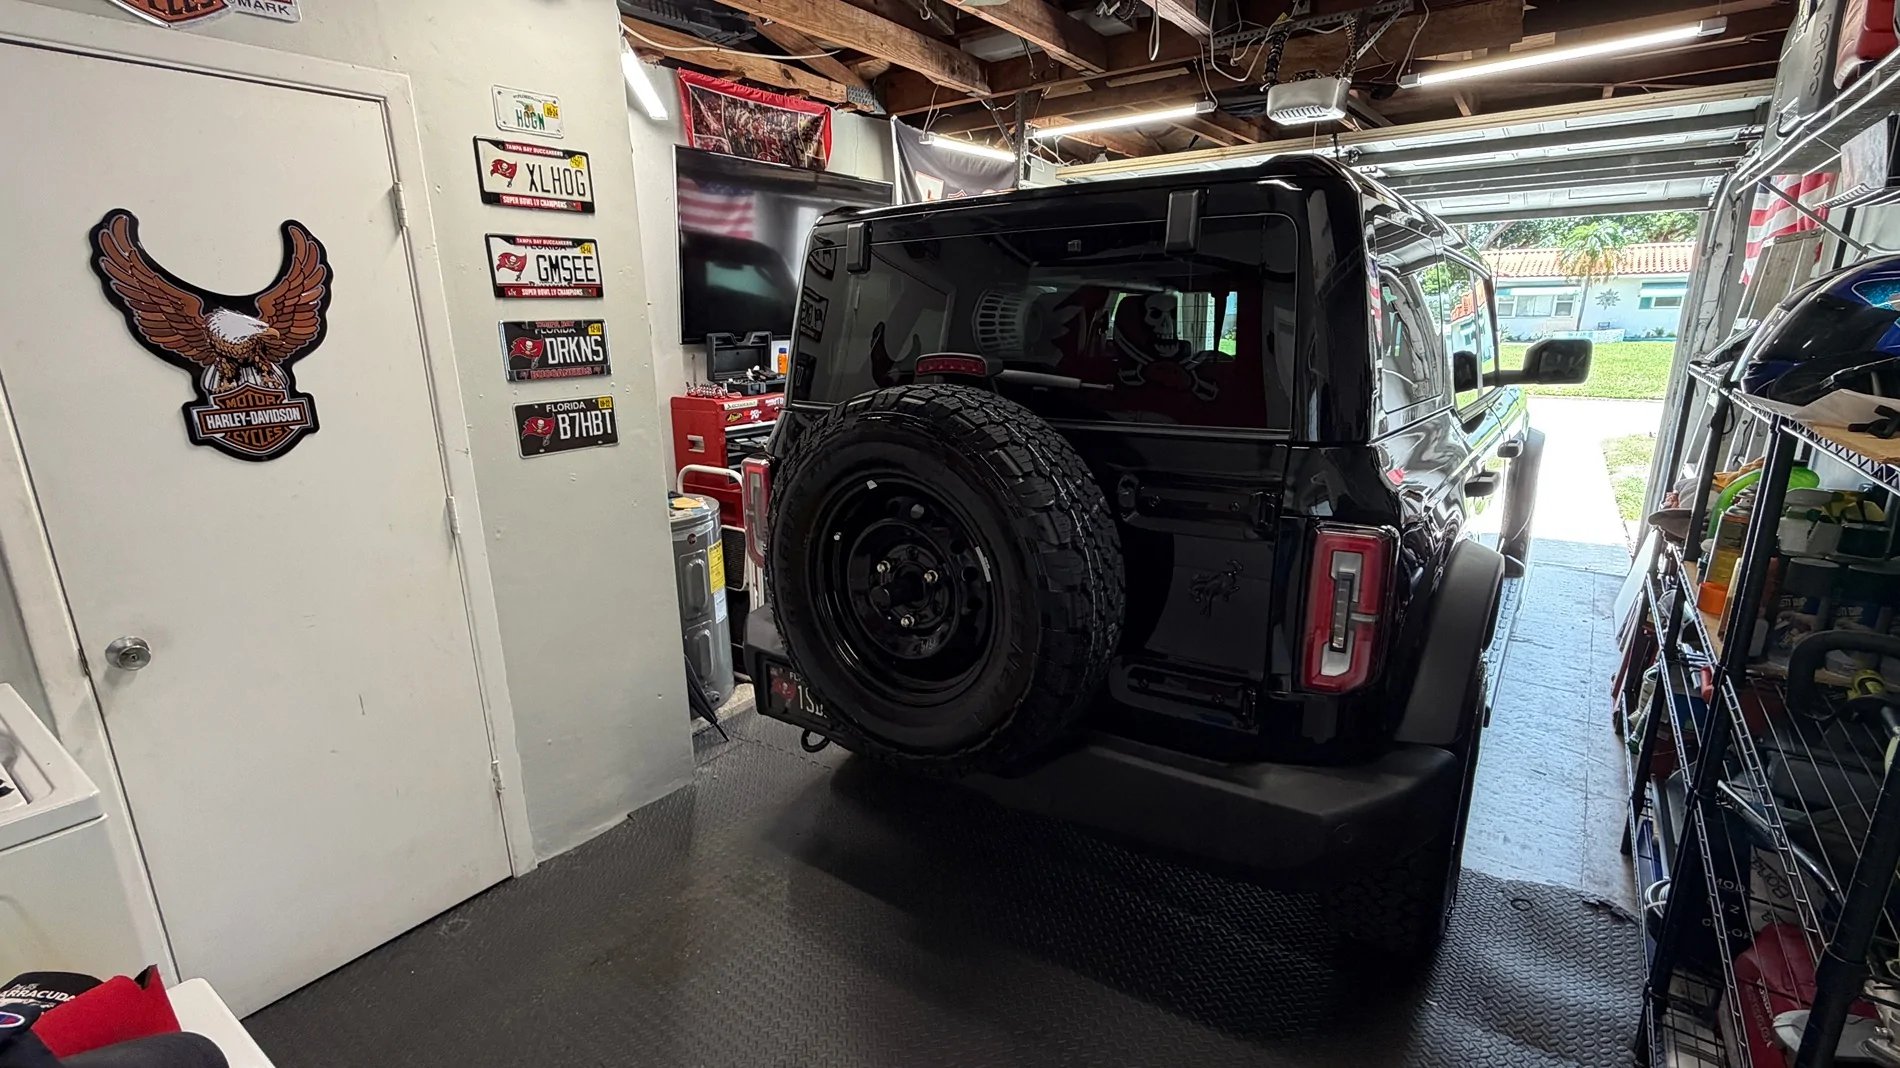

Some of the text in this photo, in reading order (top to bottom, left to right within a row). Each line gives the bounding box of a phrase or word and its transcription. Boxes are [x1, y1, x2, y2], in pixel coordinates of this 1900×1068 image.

[505, 143, 522, 151] TAMPA
[533, 148, 564, 156] BUCCANEERS
[526, 163, 586, 197] XLHOG
[502, 196, 519, 205] SUPER
[519, 197, 533, 206] BOWL
[540, 199, 567, 208] CHAMPIONS
[536, 254, 597, 283] GMSEE
[521, 287, 538, 296] SUPER
[538, 288, 551, 296] BOWL
[557, 288, 583, 297] CHAMPIONS
[545, 335, 604, 365] DRKNS
[225, 391, 276, 409] MOTOR
[546, 401, 587, 413] FLORIDA
[205, 407, 302, 430] HARLEY-DAVIDSON
[556, 409, 612, 440] B7HBT
[232, 426, 284, 447] CYCLES
